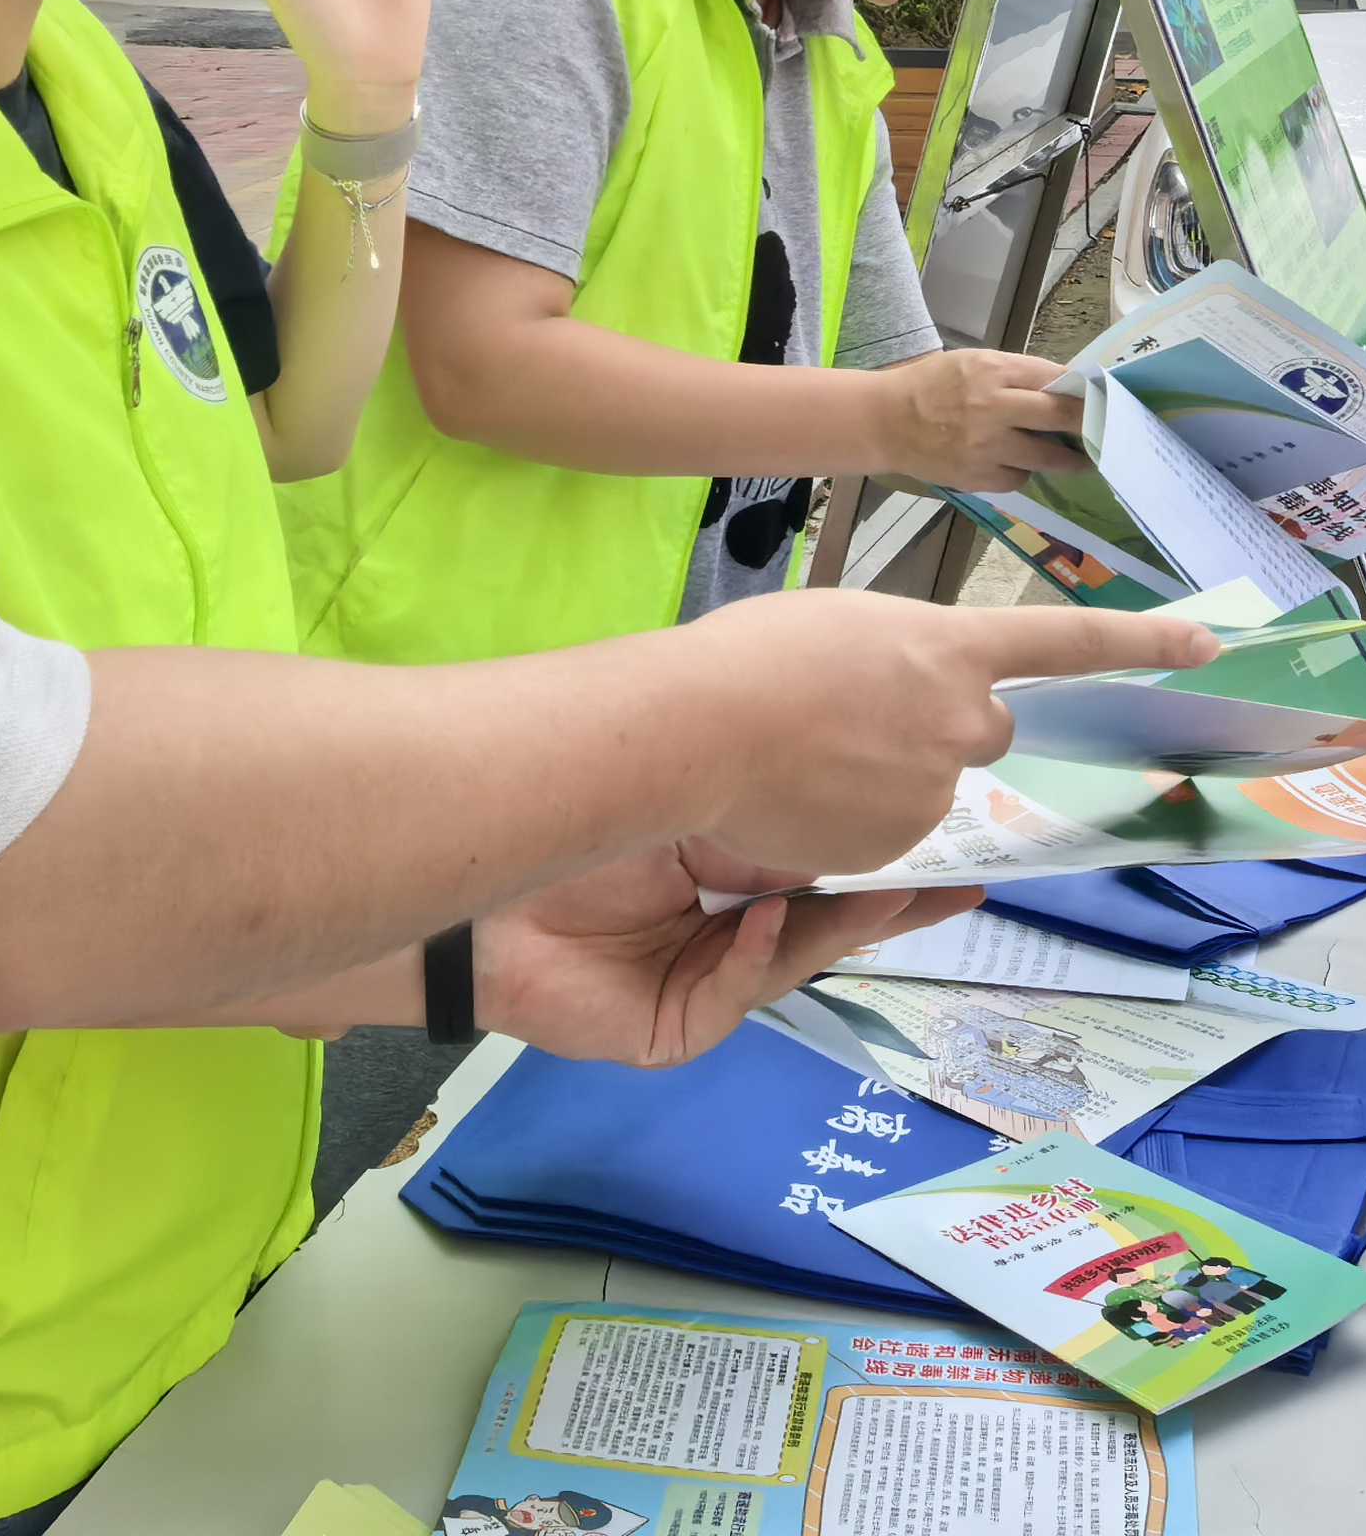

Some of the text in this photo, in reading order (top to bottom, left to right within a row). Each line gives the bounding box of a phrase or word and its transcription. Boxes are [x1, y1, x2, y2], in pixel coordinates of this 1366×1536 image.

[940, 1177, 1094, 1245] 法律进乡村
